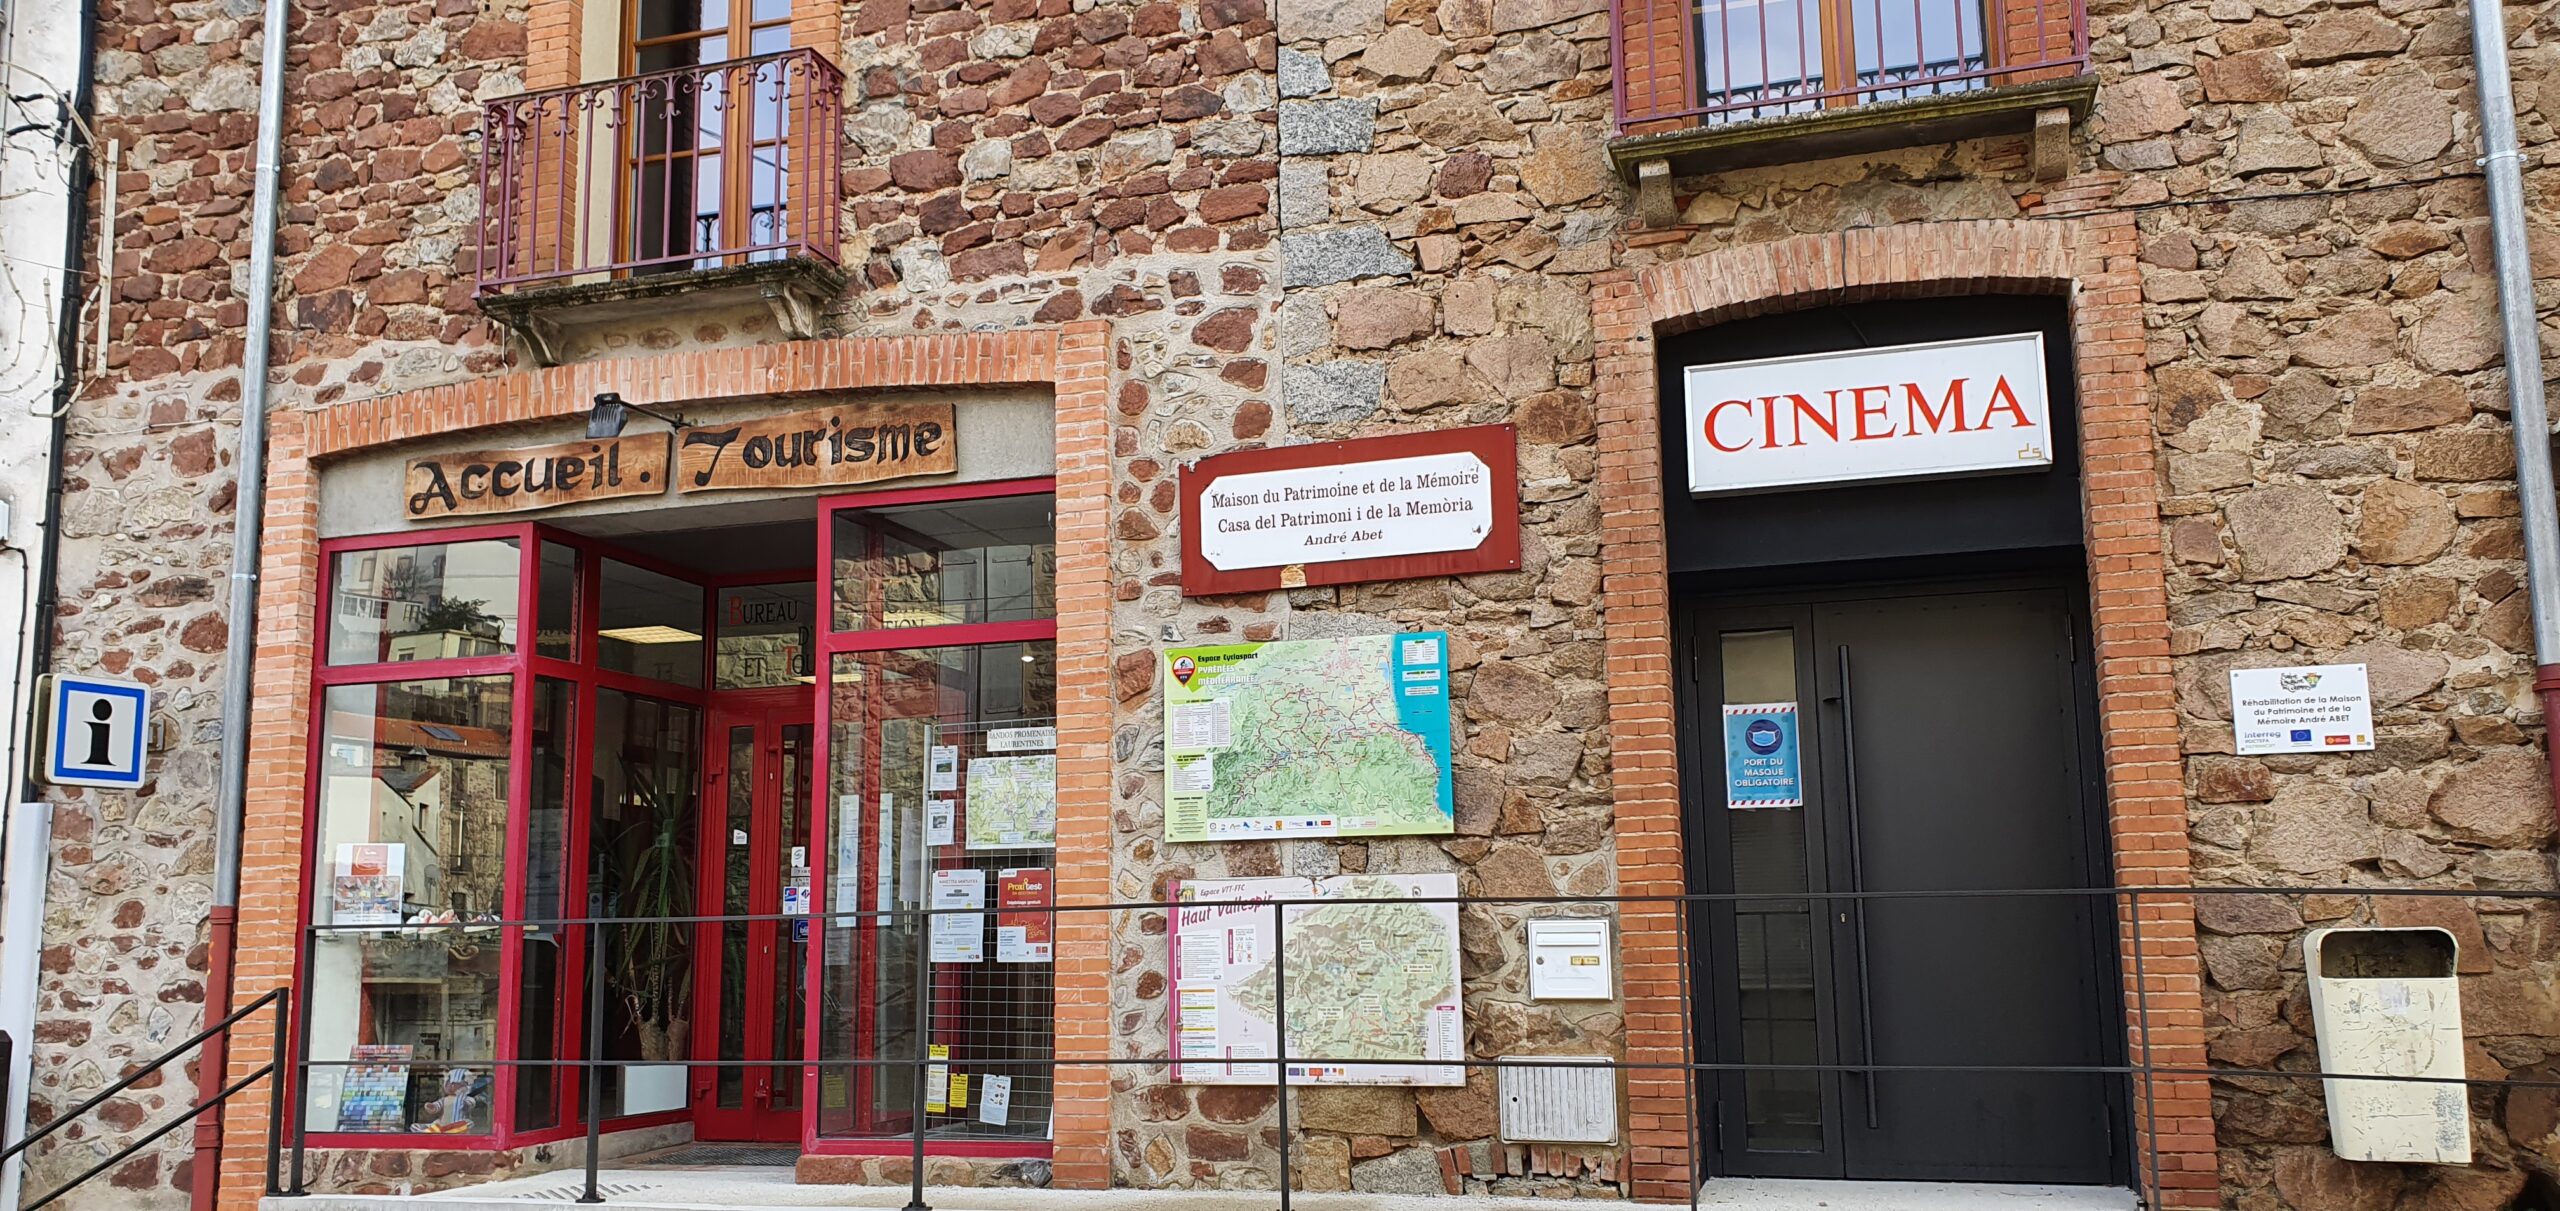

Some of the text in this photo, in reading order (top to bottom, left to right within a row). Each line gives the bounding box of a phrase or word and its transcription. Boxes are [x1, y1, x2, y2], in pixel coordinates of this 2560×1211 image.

[1703, 374, 2037, 453] CINEMA
[409, 441, 623, 514] Accueil
[682, 416, 943, 487] Tourisme
[1210, 471, 1479, 509] Maison du Patrimoine et de la Mémoire
[1217, 498, 1474, 533] Casa del Patrimoni i de la Memòria
[1304, 529, 1383, 546] André Abet
[729, 596, 798, 625] BUREAU
[1197, 652, 1259, 663] Espace Cyclosport
[744, 657, 764, 678] ET
[2242, 696, 2301, 707] Réhabilitation
[2329, 695, 2362, 703] Maison
[2267, 707, 2314, 715] Patrimoine
[2257, 714, 2350, 725] Mémoire André ABET
[1770, 758, 1783, 766] DU
[1744, 768, 1784, 777] MASQUE
[1734, 778, 1794, 787] OBLIGATOIRE
[1200, 888, 1220, 897] Espace
[1181, 890, 1273, 927] Haut Vallespir
